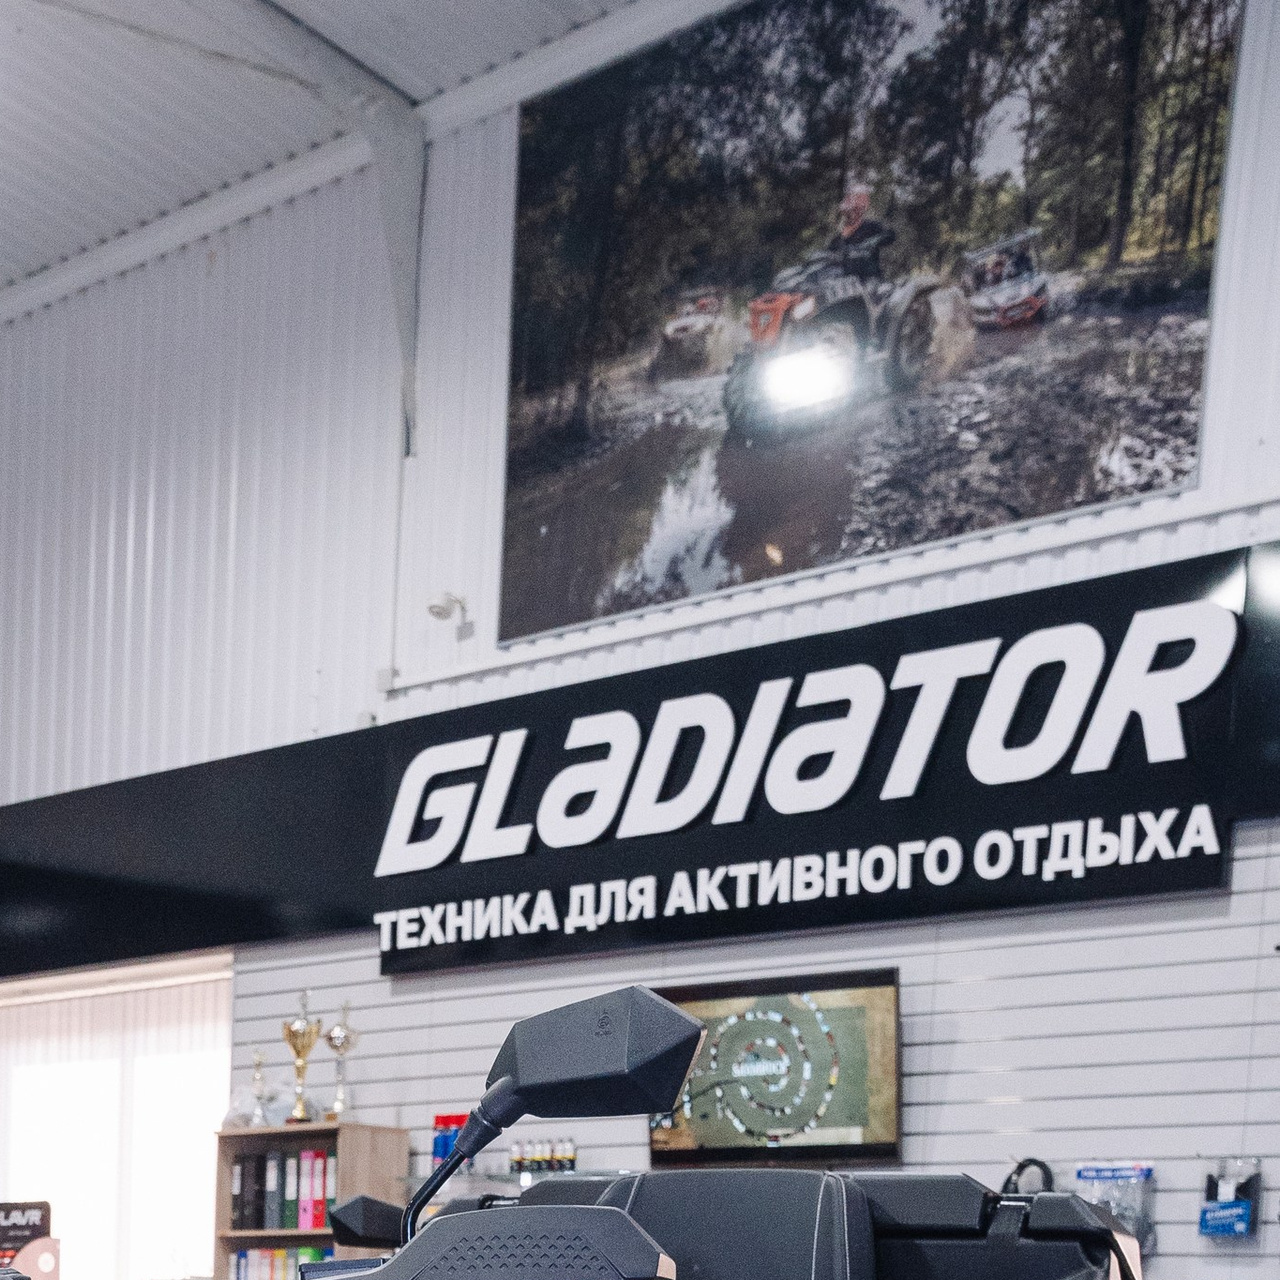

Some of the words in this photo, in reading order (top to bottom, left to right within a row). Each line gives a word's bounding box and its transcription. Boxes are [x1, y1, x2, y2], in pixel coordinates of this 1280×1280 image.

[373, 890, 559, 952] ТЕХНИКА
[564, 875, 657, 934] ДЛЯ
[664, 836, 964, 917] АКТИВНОГО
[973, 804, 1220, 881] ОТДЫХА
